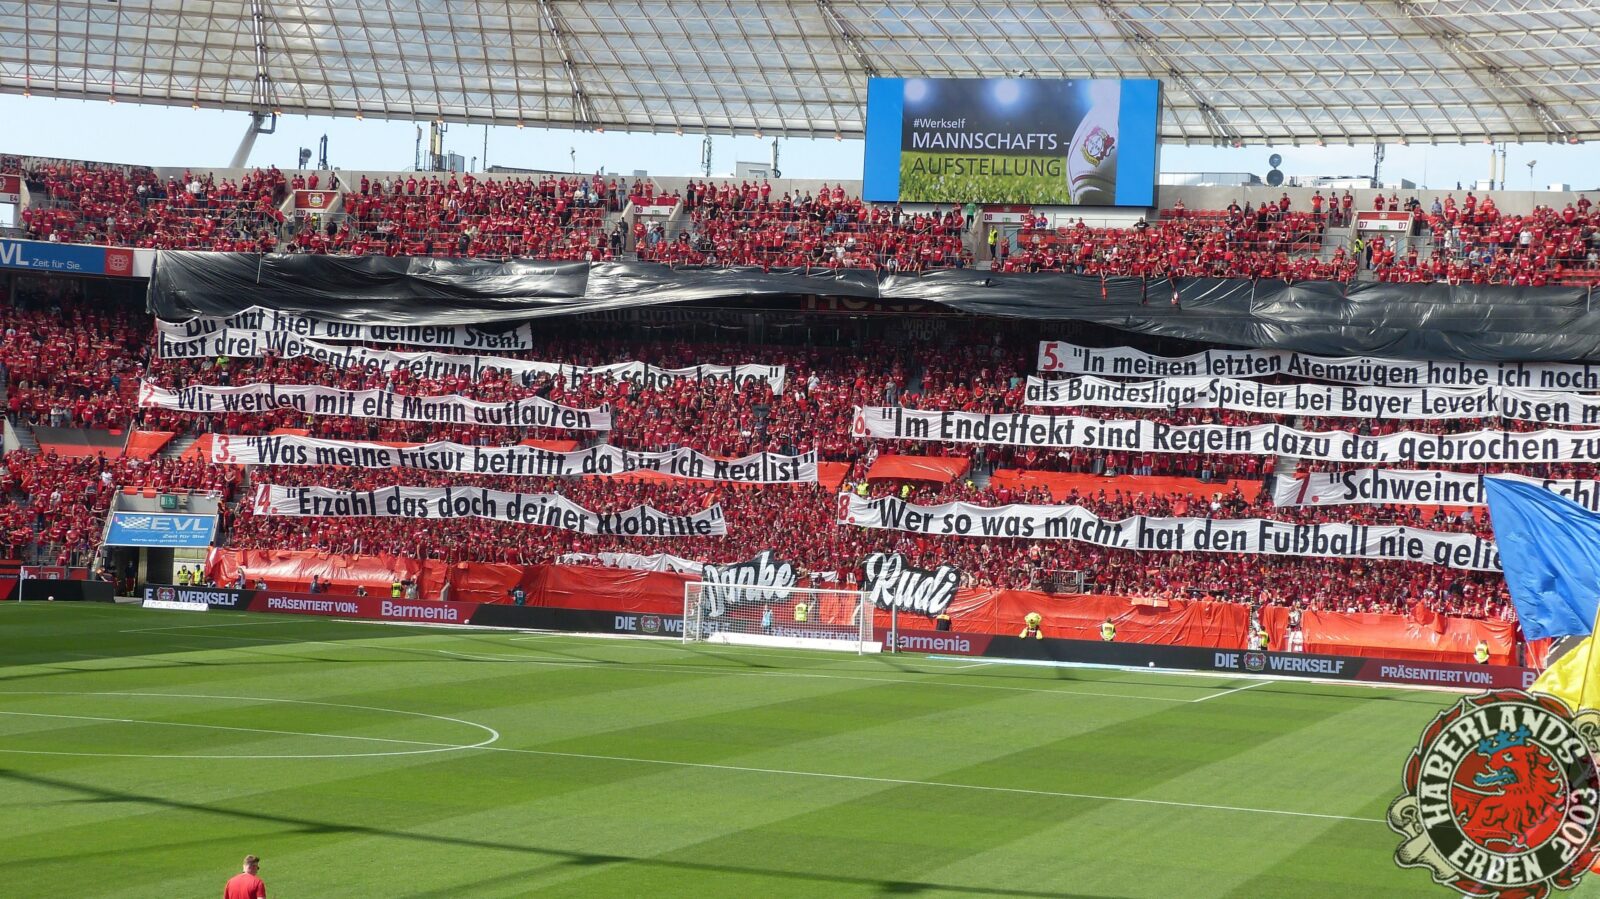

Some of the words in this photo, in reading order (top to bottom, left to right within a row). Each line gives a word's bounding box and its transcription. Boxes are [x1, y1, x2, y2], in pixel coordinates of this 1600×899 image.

[912, 118, 966, 130] #Werkself
[912, 132, 1058, 150] MANNSCHAFTS
[911, 156, 1062, 177] AUFSTELLUNG
[1359, 221, 1368, 229] D7
[1398, 221, 1407, 229] D7
[32, 258, 50, 268] Zeit
[52, 258, 65, 269] für
[273, 310, 320, 337] hier
[371, 324, 456, 345] deinem
[160, 330, 208, 357] hast
[215, 328, 258, 357] drei
[1043, 343, 1064, 371] 5.
[1073, 347, 1105, 372] "In
[1113, 353, 1197, 376] meinen
[1204, 350, 1281, 376] letzten
[1287, 352, 1418, 386] Atemzügen
[1427, 360, 1489, 385] habe
[1497, 362, 1530, 387] ich
[1541, 364, 1599, 389] noch
[221, 384, 307, 412] werden
[315, 392, 358, 416] mit
[401, 396, 467, 422] Mann
[1027, 378, 1060, 402] als
[1068, 376, 1288, 409] Bundesliga-Spieler
[1296, 385, 1332, 411] bei
[1342, 387, 1413, 419] Bayer
[1421, 387, 1570, 423] Leverkusen
[881, 407, 929, 437] "Im
[941, 410, 1075, 445] Endeffekt
[1083, 419, 1141, 449] sind
[1153, 422, 1252, 453] Regeln
[1263, 424, 1331, 457] dazu
[1342, 434, 1389, 461] da,
[1398, 432, 1560, 462] gebrochen
[215, 435, 237, 463] 3.
[247, 436, 308, 464] "Was
[316, 446, 392, 467] meine
[582, 447, 613, 474] da
[670, 450, 704, 478] ich
[258, 484, 278, 515] 4.
[286, 487, 377, 516] "Erzähl
[386, 486, 429, 518] das
[438, 487, 497, 518] doch
[506, 493, 589, 533] deiner
[151, 517, 209, 531] EVL
[868, 500, 935, 532] "Wer
[942, 513, 972, 535] so
[982, 515, 1035, 537] was
[1045, 516, 1129, 547] macht,
[1138, 516, 1185, 550] hat
[1193, 518, 1248, 551] den
[1258, 519, 1369, 556] Fußball
[1379, 527, 1424, 559] nie
[866, 552, 958, 615] Rudi
[177, 590, 239, 606] WERKSELF
[267, 597, 332, 613] PRÄSENTIERT
[334, 602, 359, 614] VON:
[381, 600, 458, 621] Barmenia
[614, 615, 637, 631] DIE
[885, 627, 971, 652] Barmenia
[1214, 652, 1239, 669] DIE
[1269, 655, 1345, 675] WERKSELF
[1380, 664, 1462, 683] PRÄSENTIERT
[1463, 671, 1493, 685] VON:
